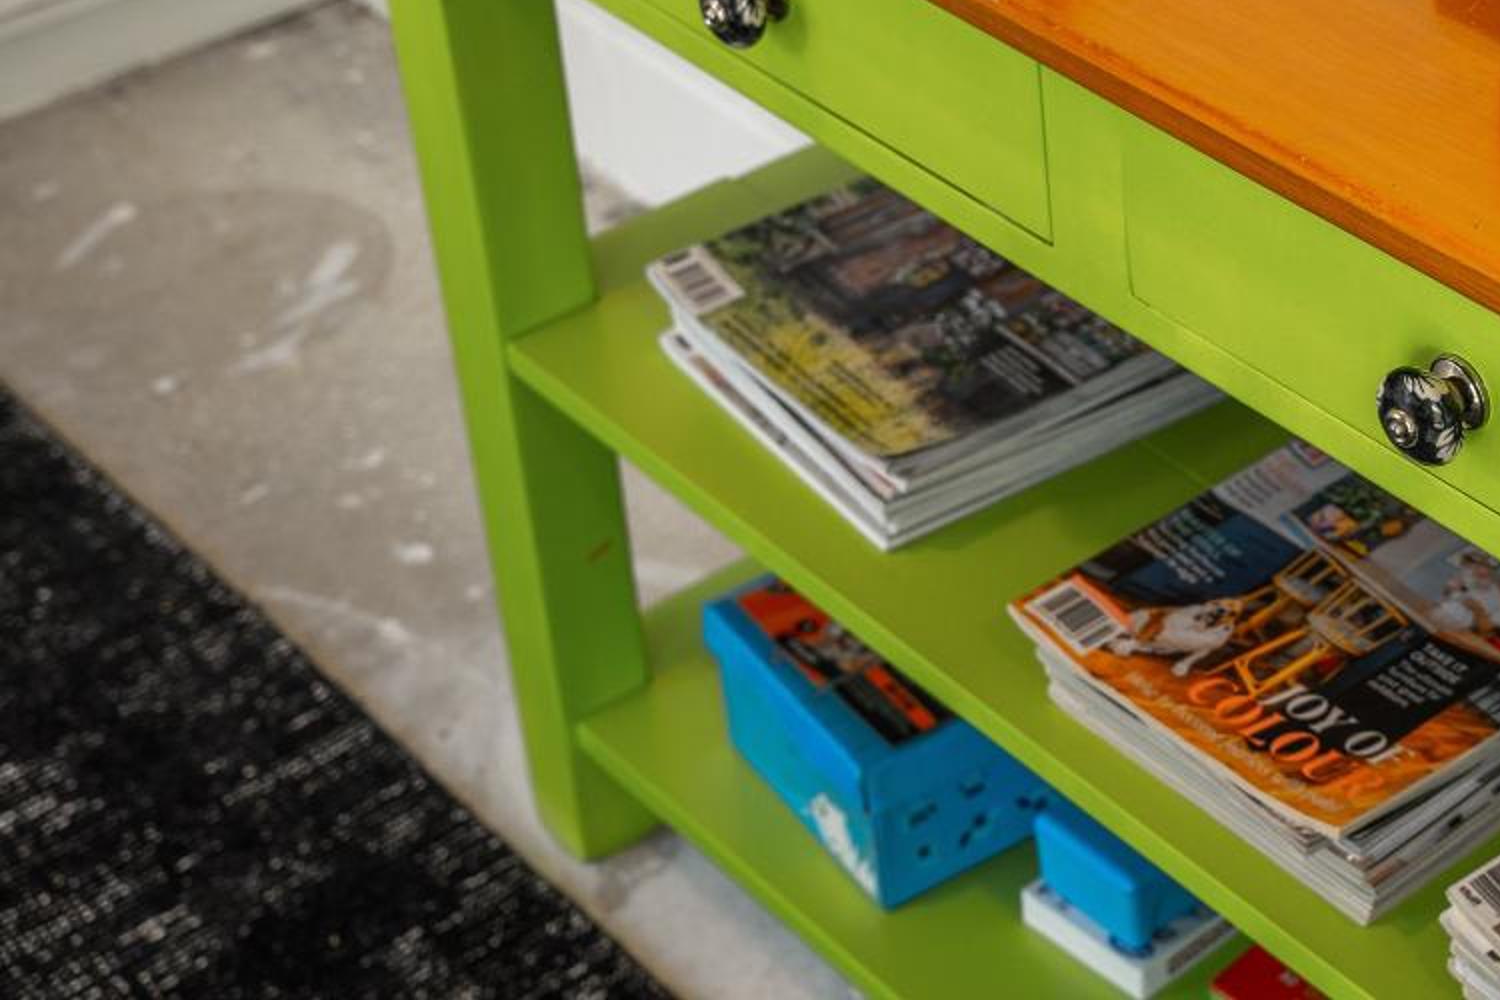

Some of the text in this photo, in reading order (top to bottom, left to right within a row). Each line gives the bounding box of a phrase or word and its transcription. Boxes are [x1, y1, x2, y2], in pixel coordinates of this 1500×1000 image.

[1188, 676, 1385, 800] COLOUR
[1257, 682, 1415, 765] JOY OF
